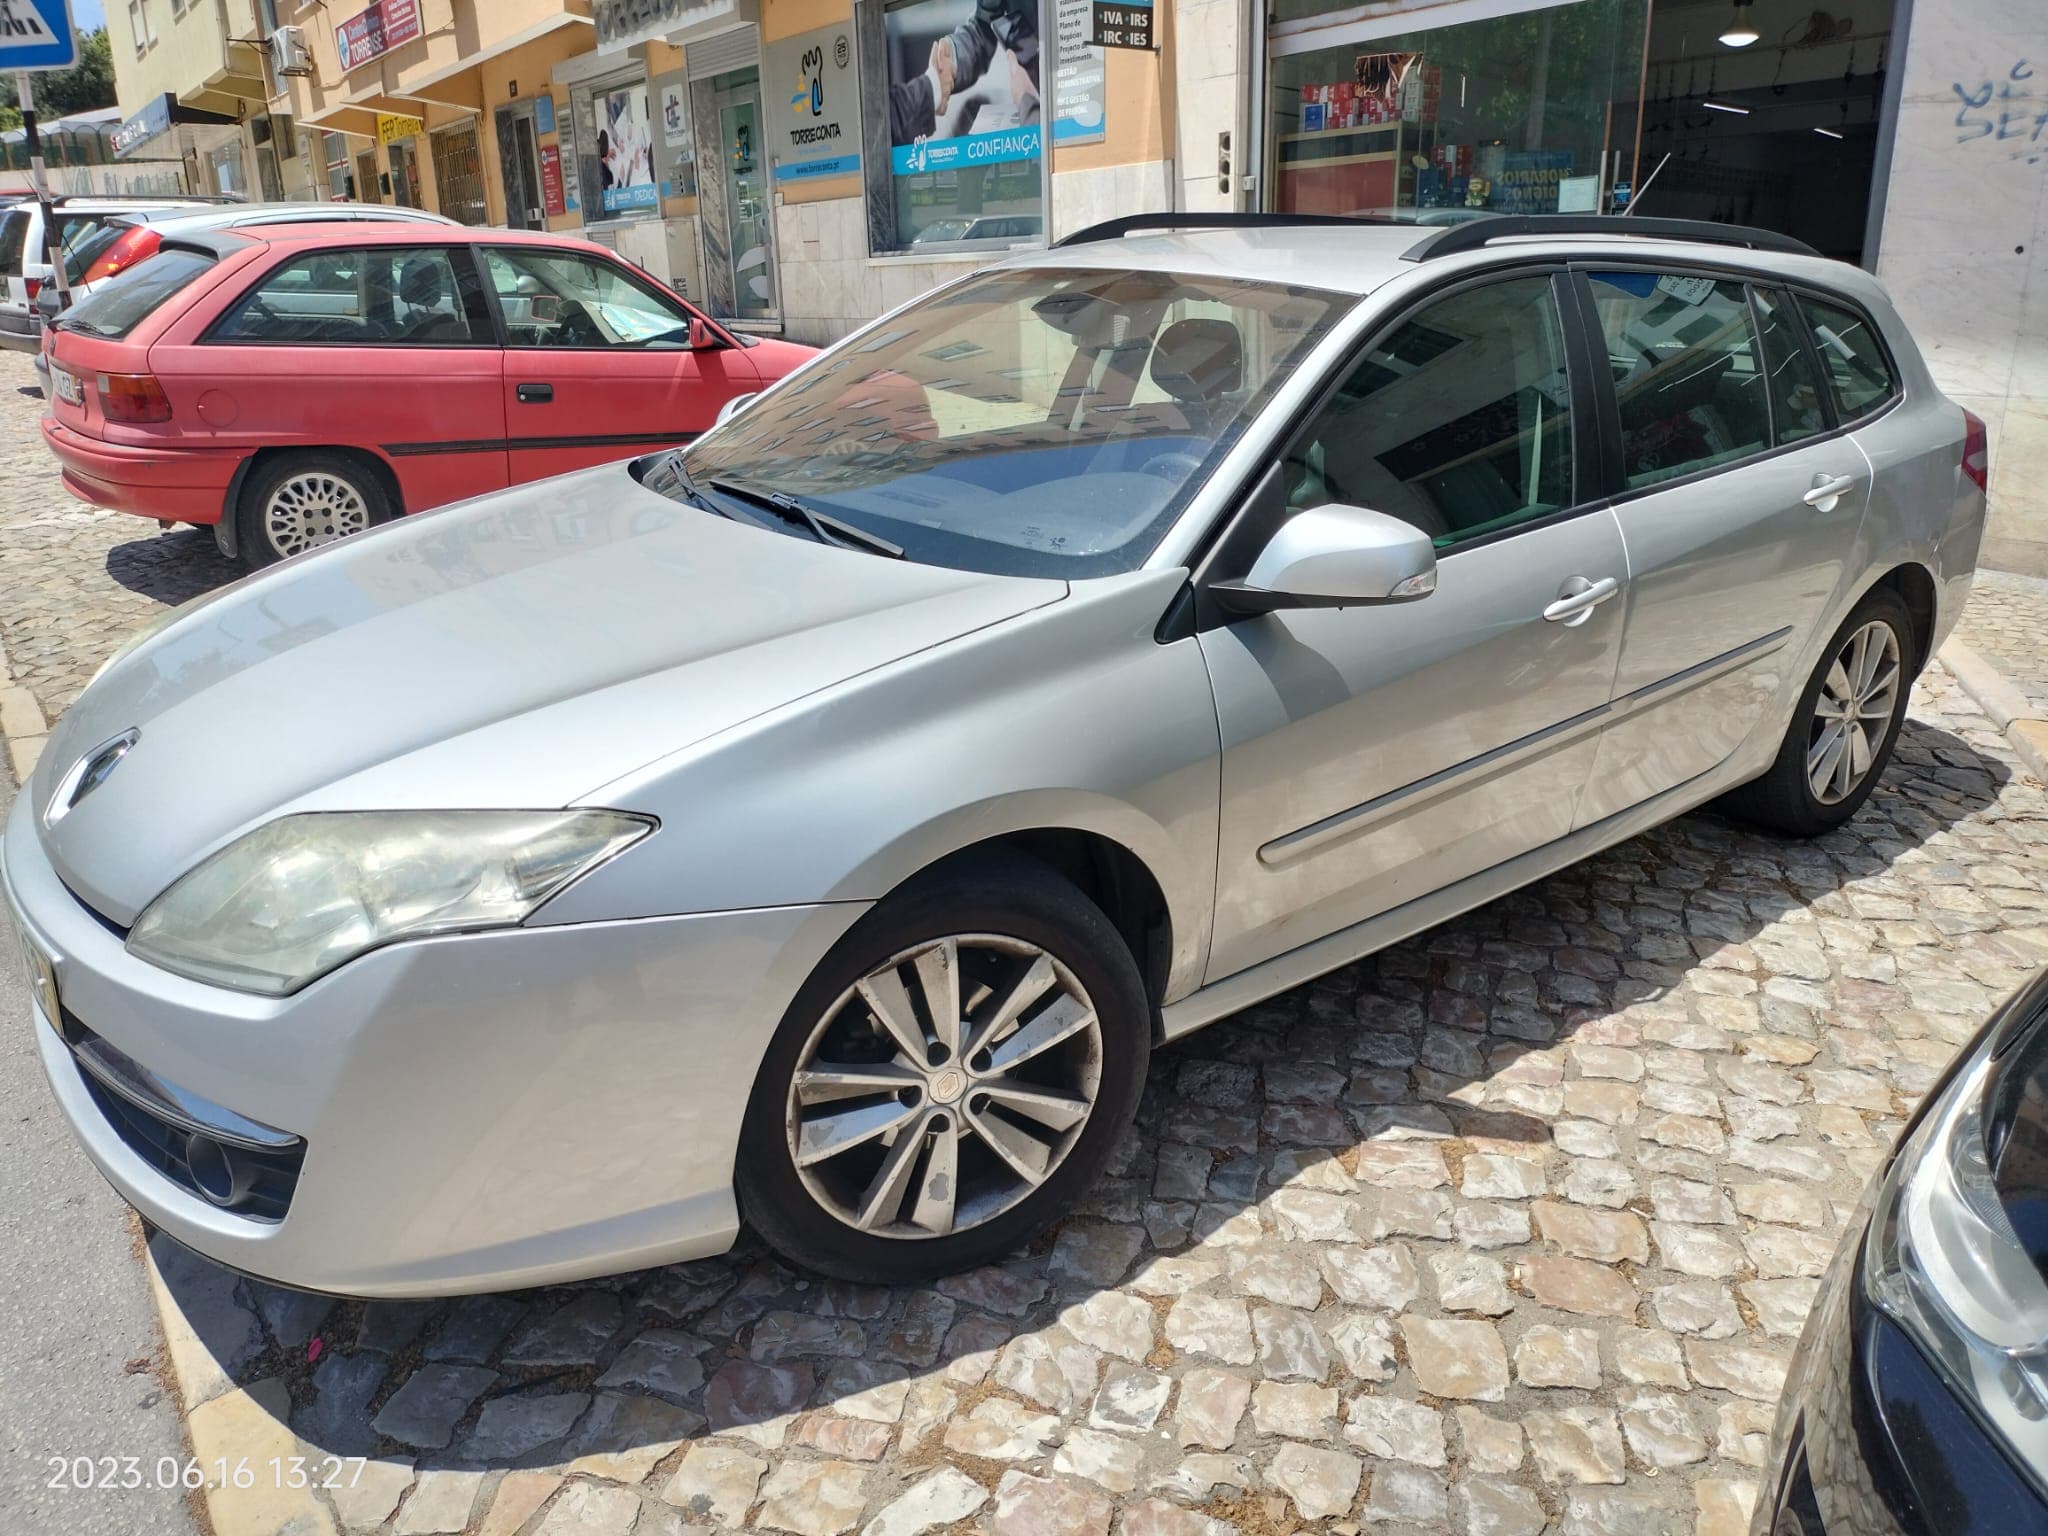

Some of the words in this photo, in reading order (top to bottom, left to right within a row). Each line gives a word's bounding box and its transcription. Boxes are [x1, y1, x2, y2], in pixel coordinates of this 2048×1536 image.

[1103, 11, 1123, 25] IVA
[1130, 13, 1148, 27] IRS
[1103, 30, 1122, 44] IRC
[1129, 33, 1147, 46] IES
[790, 121, 842, 146] TORRECONTA
[967, 132, 1040, 159] CONFIANÇA
